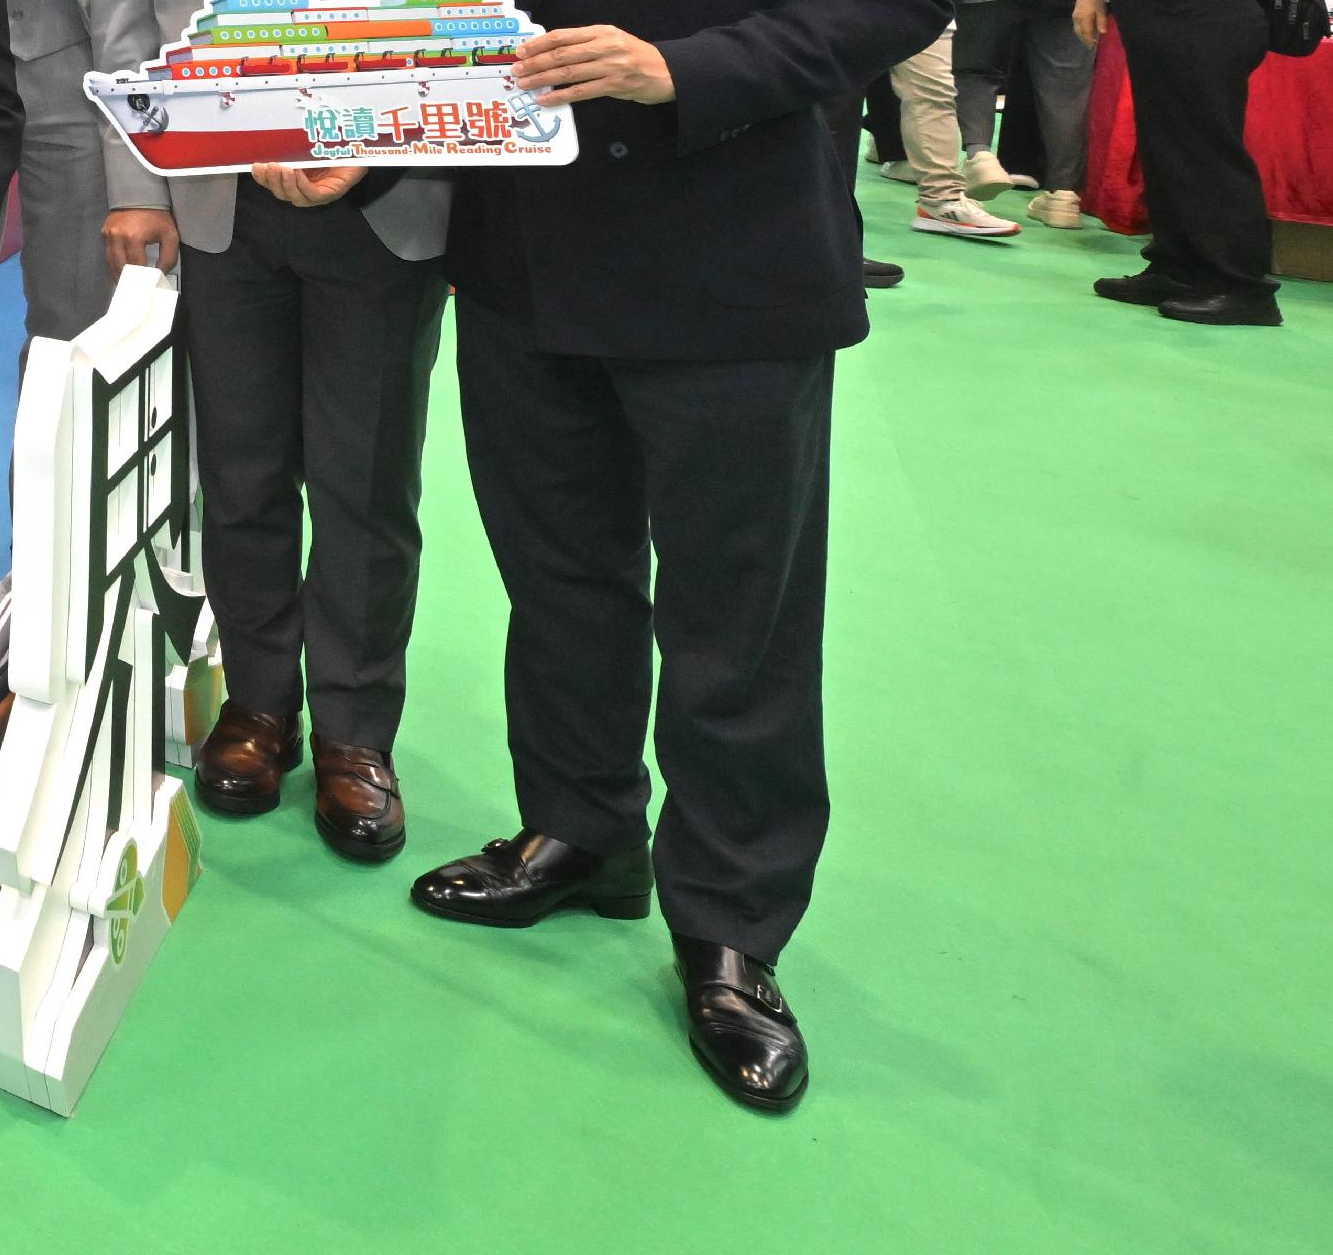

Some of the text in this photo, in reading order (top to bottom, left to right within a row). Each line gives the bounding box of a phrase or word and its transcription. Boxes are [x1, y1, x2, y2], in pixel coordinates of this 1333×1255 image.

[312, 144, 351, 158] Joyful
[445, 142, 502, 156] Reading
[503, 141, 552, 154] Cruise
